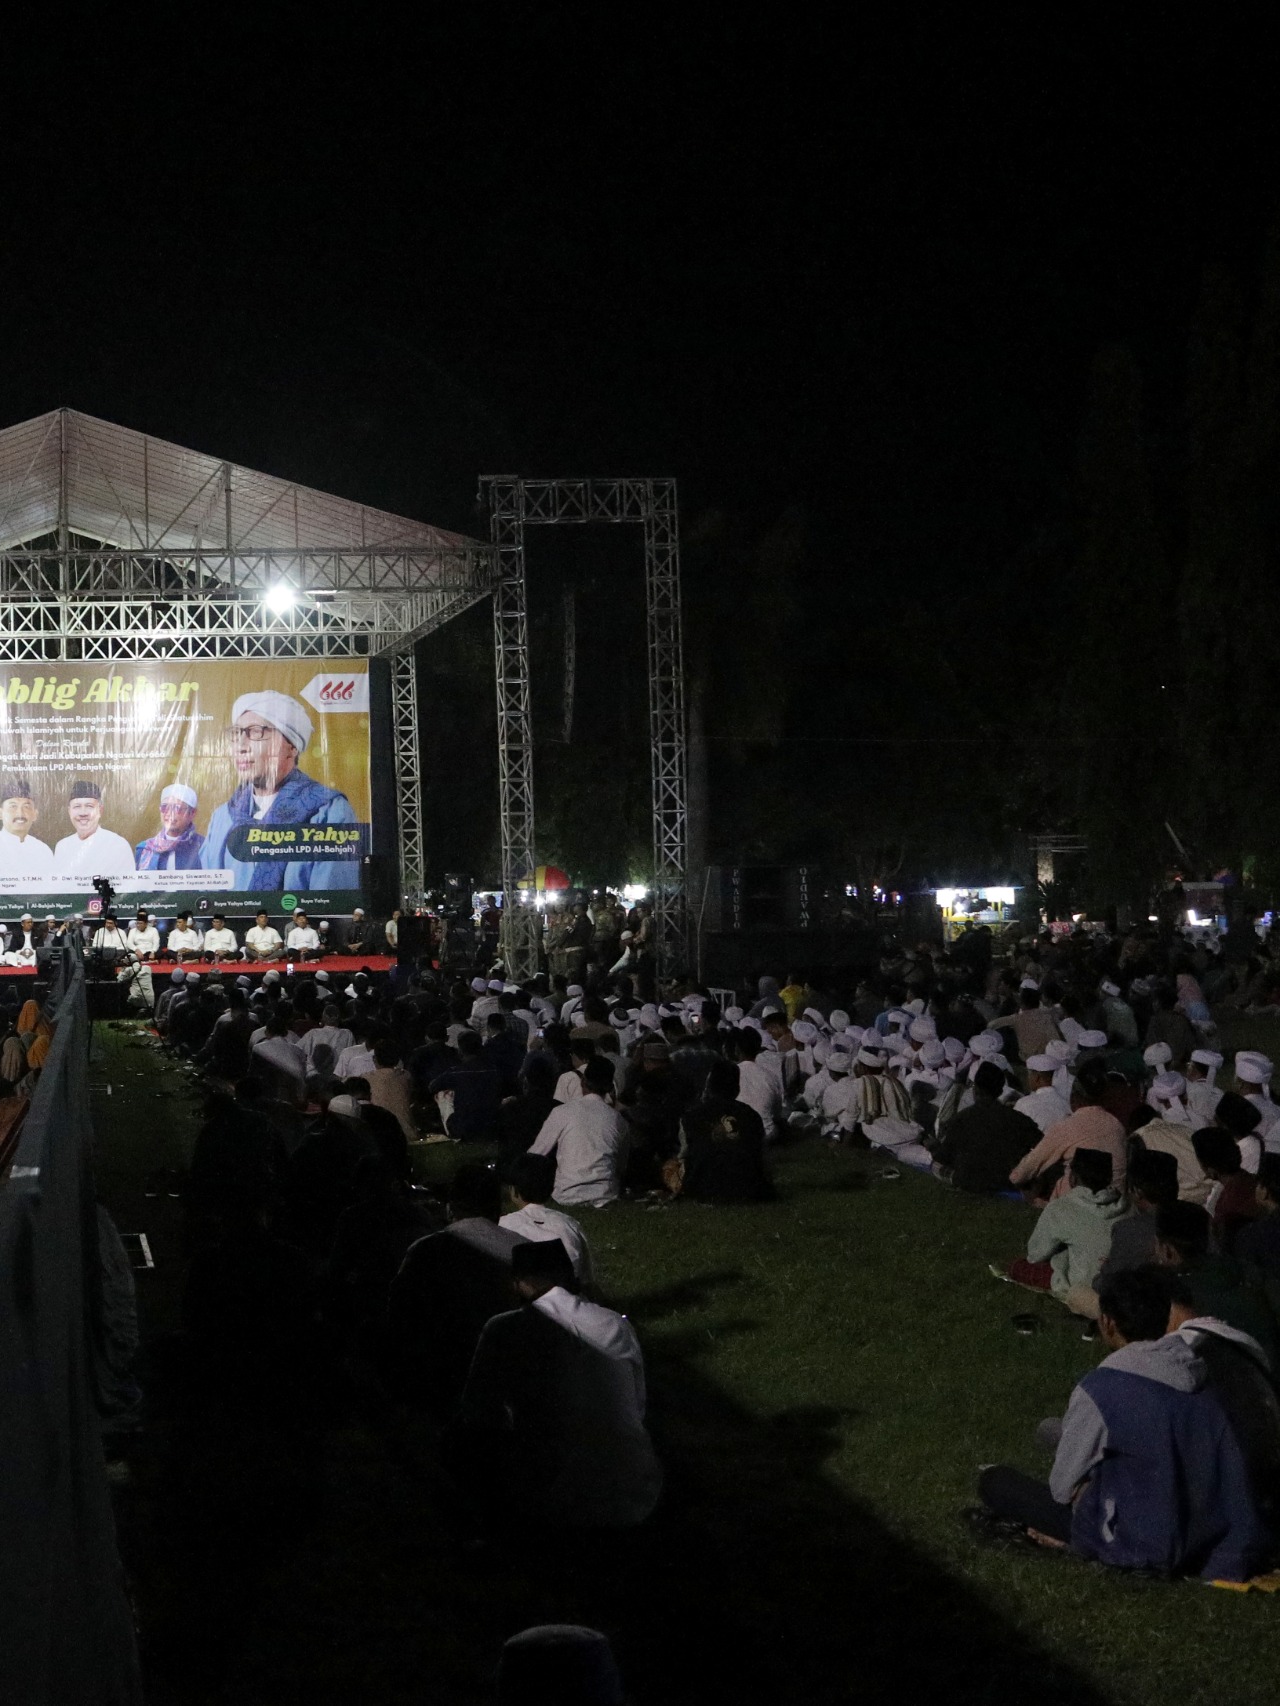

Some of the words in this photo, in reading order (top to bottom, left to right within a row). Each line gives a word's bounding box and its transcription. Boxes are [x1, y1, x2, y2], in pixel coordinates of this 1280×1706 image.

[81, 675, 200, 703] Akbar
[14, 716, 48, 724] Semesta
[75, 715, 107, 724] Rangka
[26, 725, 65, 735] Islamiyah
[20, 752, 38, 760] Hari
[39, 752, 57, 760] Jadi
[58, 752, 105, 761] Kabupaten
[106, 751, 134, 760] Ngawi
[1, 764, 48, 772] Pembukaan
[49, 763, 64, 771] LPD
[64, 763, 104, 772] Al-Bahjah
[105, 762, 132, 771] Ngawi
[246, 828, 296, 845] Buya
[301, 826, 360, 845] Yahya
[250, 845, 294, 855] (Pengasuh
[312, 844, 356, 855] Al-Bahjah)
